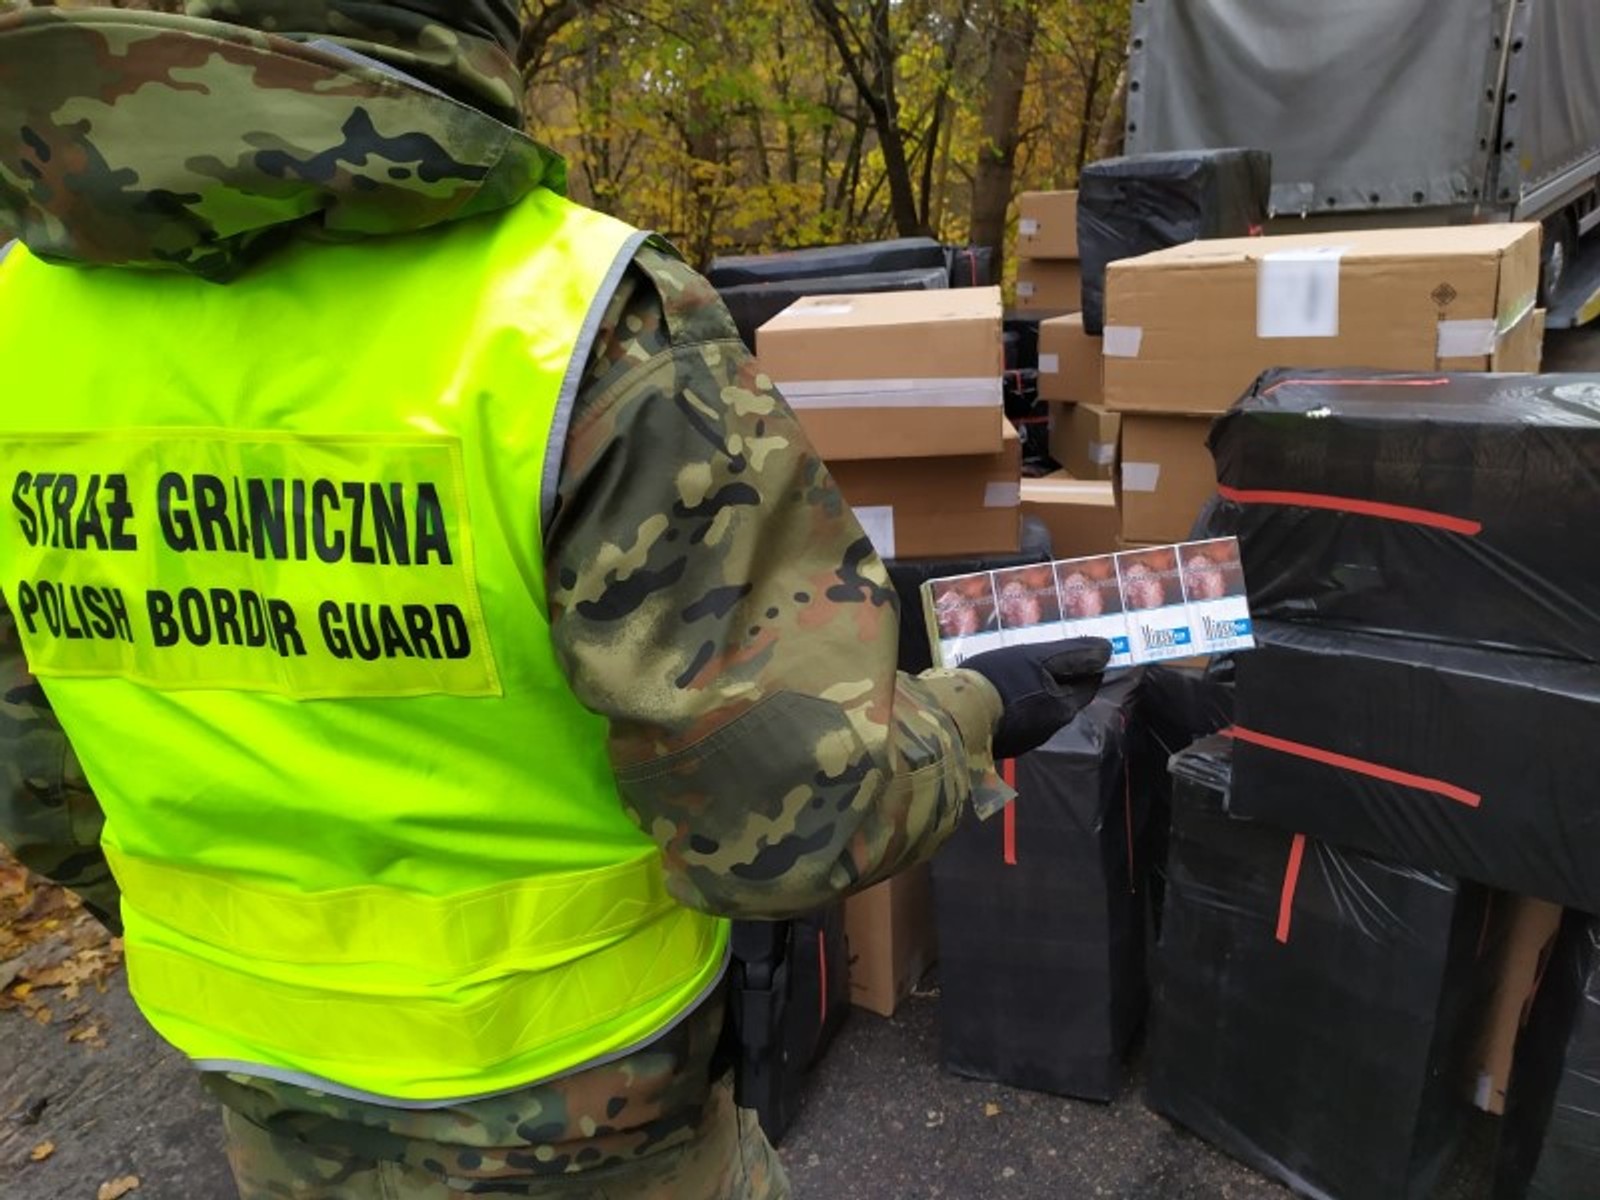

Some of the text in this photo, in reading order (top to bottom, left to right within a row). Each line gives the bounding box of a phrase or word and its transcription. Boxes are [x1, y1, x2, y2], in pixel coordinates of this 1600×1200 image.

[18, 580, 471, 661] POLISH BORDR GUARD
